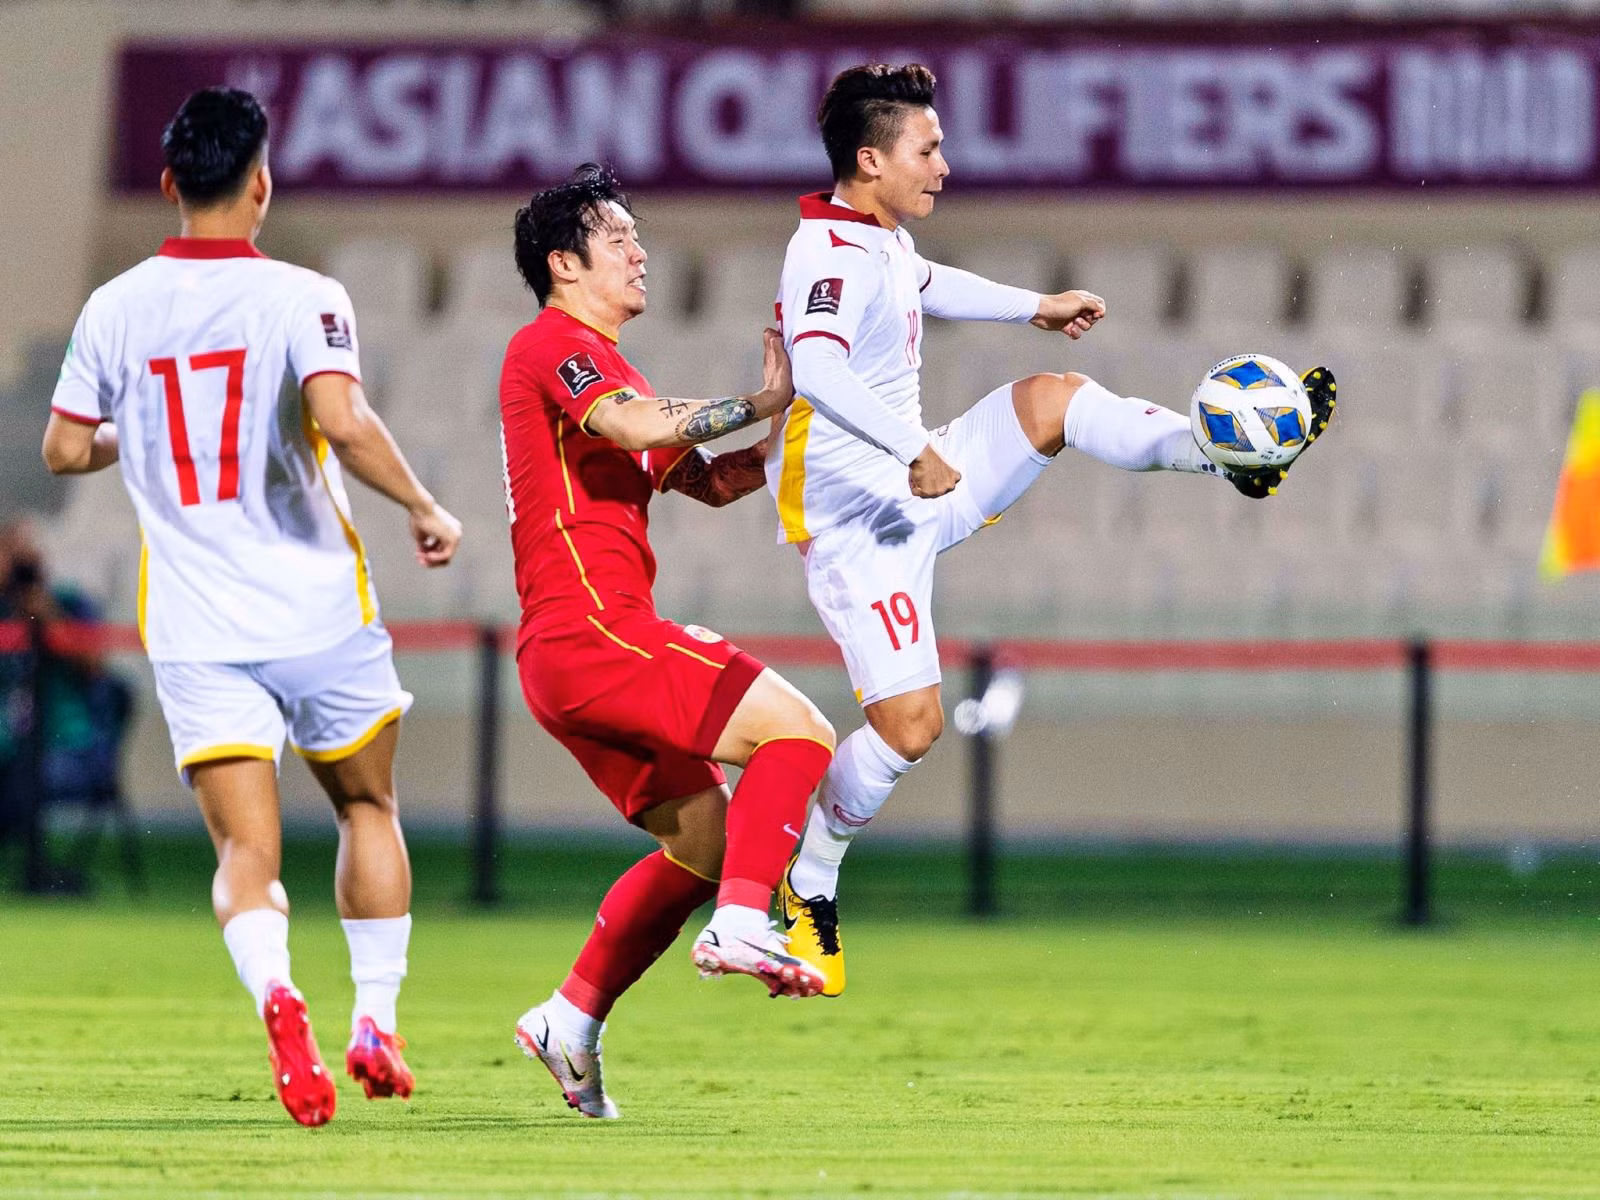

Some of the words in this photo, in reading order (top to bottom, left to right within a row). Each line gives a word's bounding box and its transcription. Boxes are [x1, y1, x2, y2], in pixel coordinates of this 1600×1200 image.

[272, 50, 666, 178] ASIAN
[676, 50, 1380, 178] QULIFIERS
[148, 349, 248, 506] 17
[870, 591, 919, 651] 19
